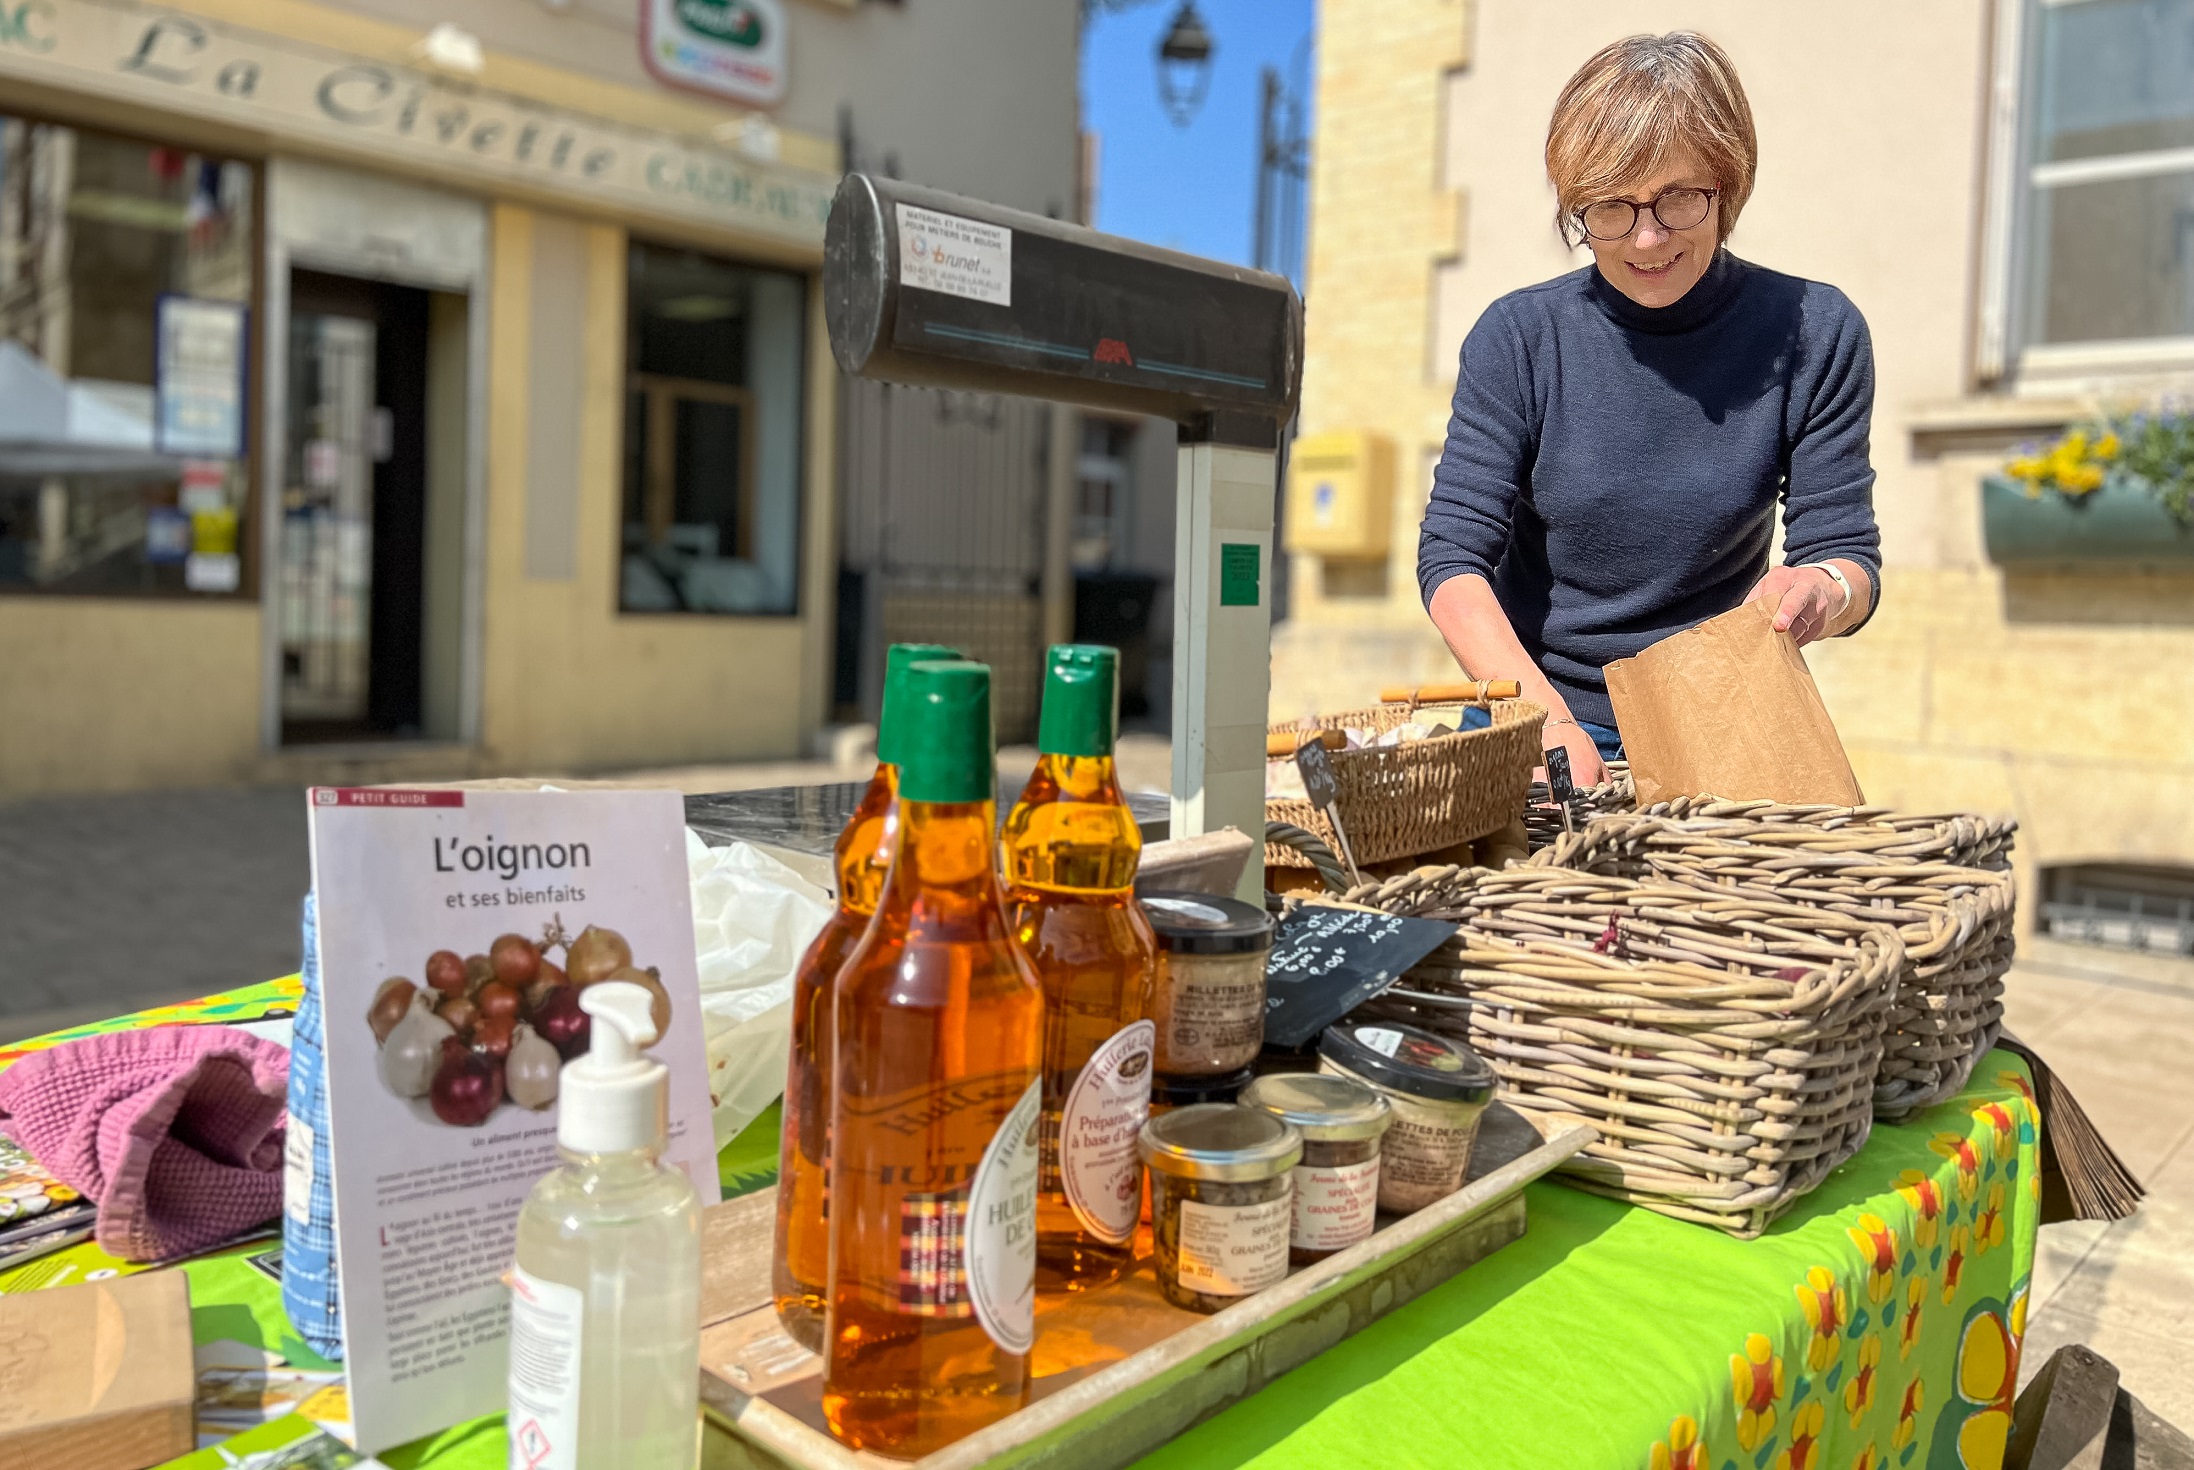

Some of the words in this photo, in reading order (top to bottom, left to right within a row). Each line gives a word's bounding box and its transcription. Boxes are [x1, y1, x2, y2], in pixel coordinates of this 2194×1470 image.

[117, 15, 262, 99] La
[314, 62, 618, 178] Civette
[961, 233, 972, 243] DE
[932, 244, 980, 272] brunet
[352, 793, 385, 804] PETIT
[390, 793, 428, 804] GUIDE
[434, 834, 591, 880] L'oignon
[446, 893, 465, 907] et
[472, 892, 501, 906] ses
[507, 885, 586, 905] bienfaits
[472, 1137, 487, 1147] Un
[488, 1131, 522, 1145] aliment
[1072, 1135, 1080, 1149] à
[1084, 1130, 1110, 1148] base
[1436, 1127, 1450, 1137] DE
[1307, 1204, 1348, 1215] GRAINES
[1005, 1216, 1024, 1247] DE
[1231, 1243, 1272, 1255] GRAINES
